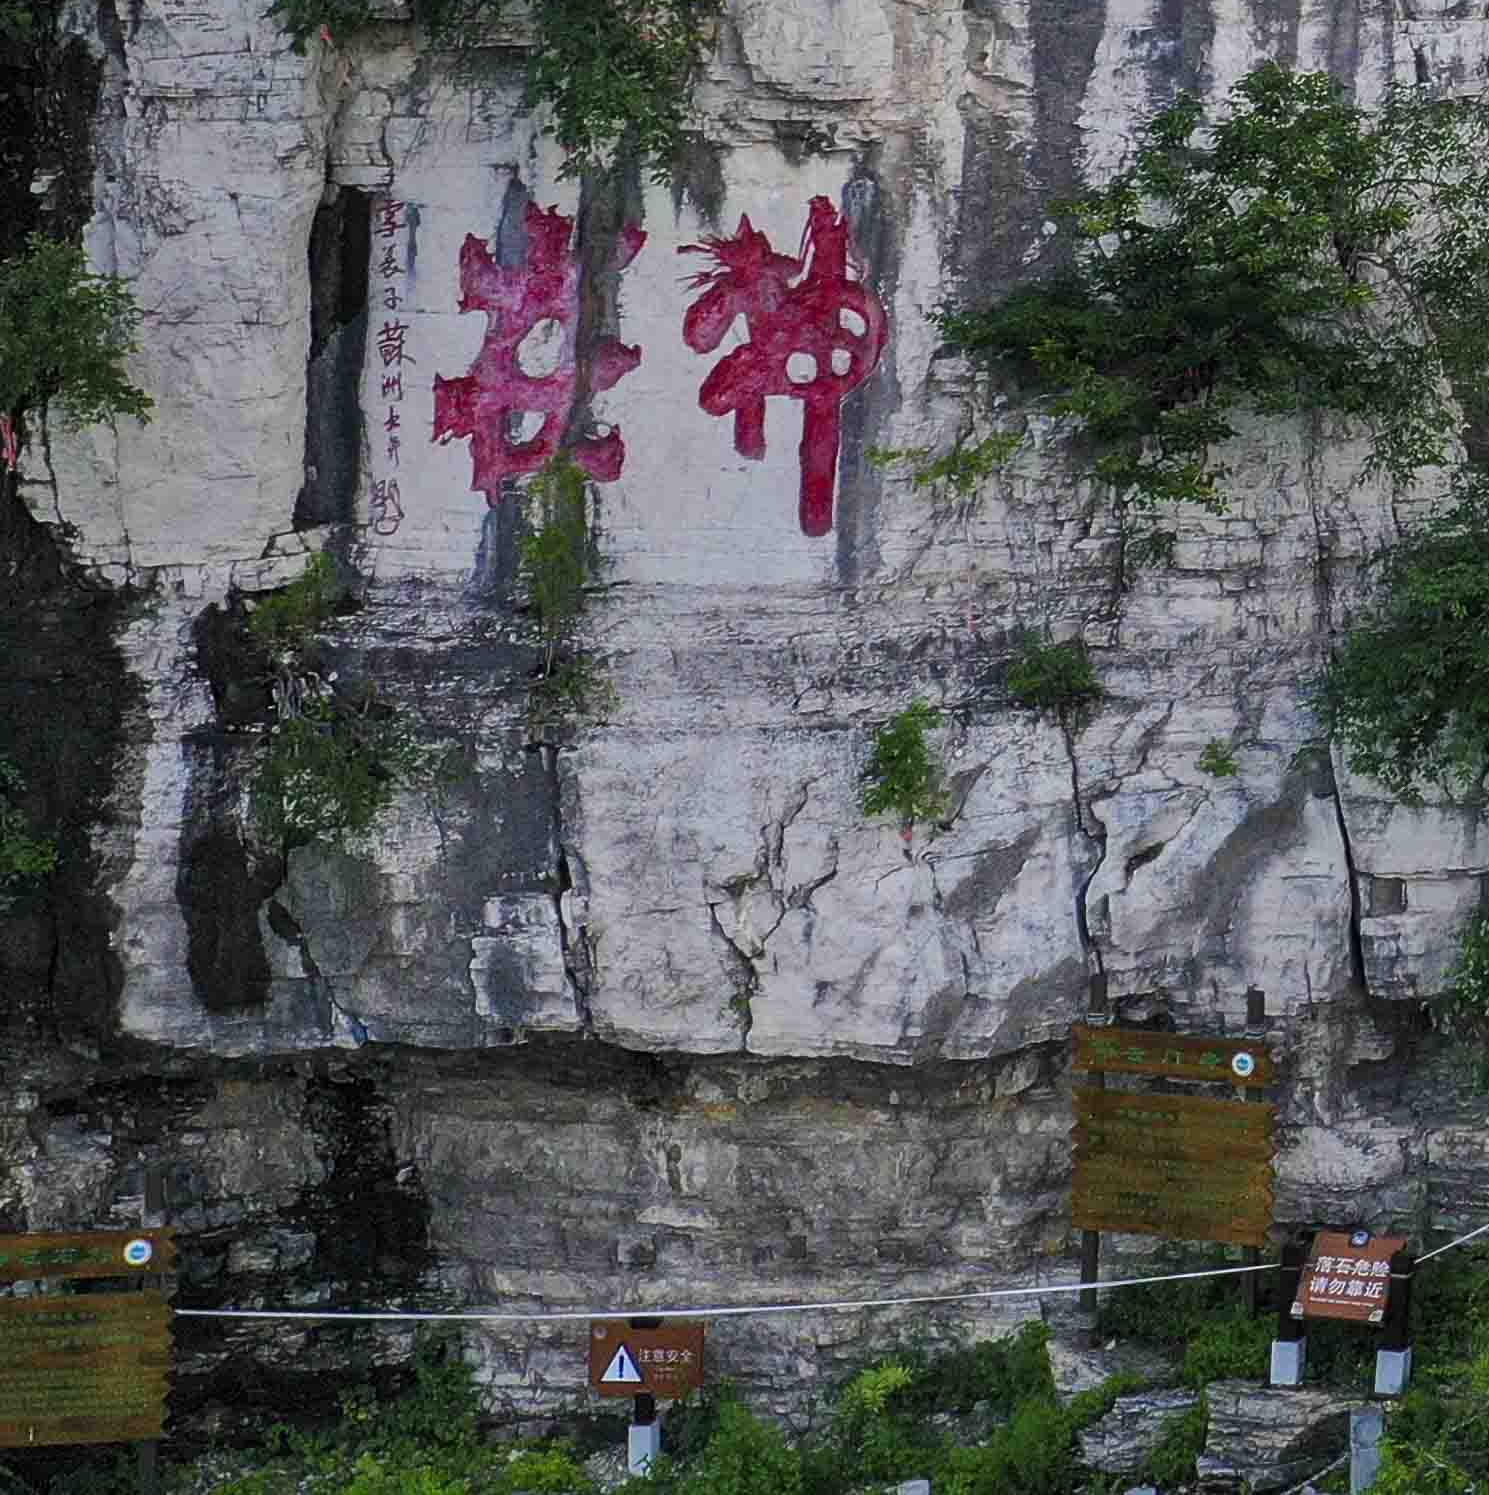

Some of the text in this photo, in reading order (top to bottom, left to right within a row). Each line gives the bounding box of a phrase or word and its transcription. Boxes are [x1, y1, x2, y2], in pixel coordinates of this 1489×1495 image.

[1315, 1255, 1391, 1278] 落石危险
[1309, 1276, 1385, 1299] 请勿靠近
[639, 1347, 695, 1363] 注意安全
